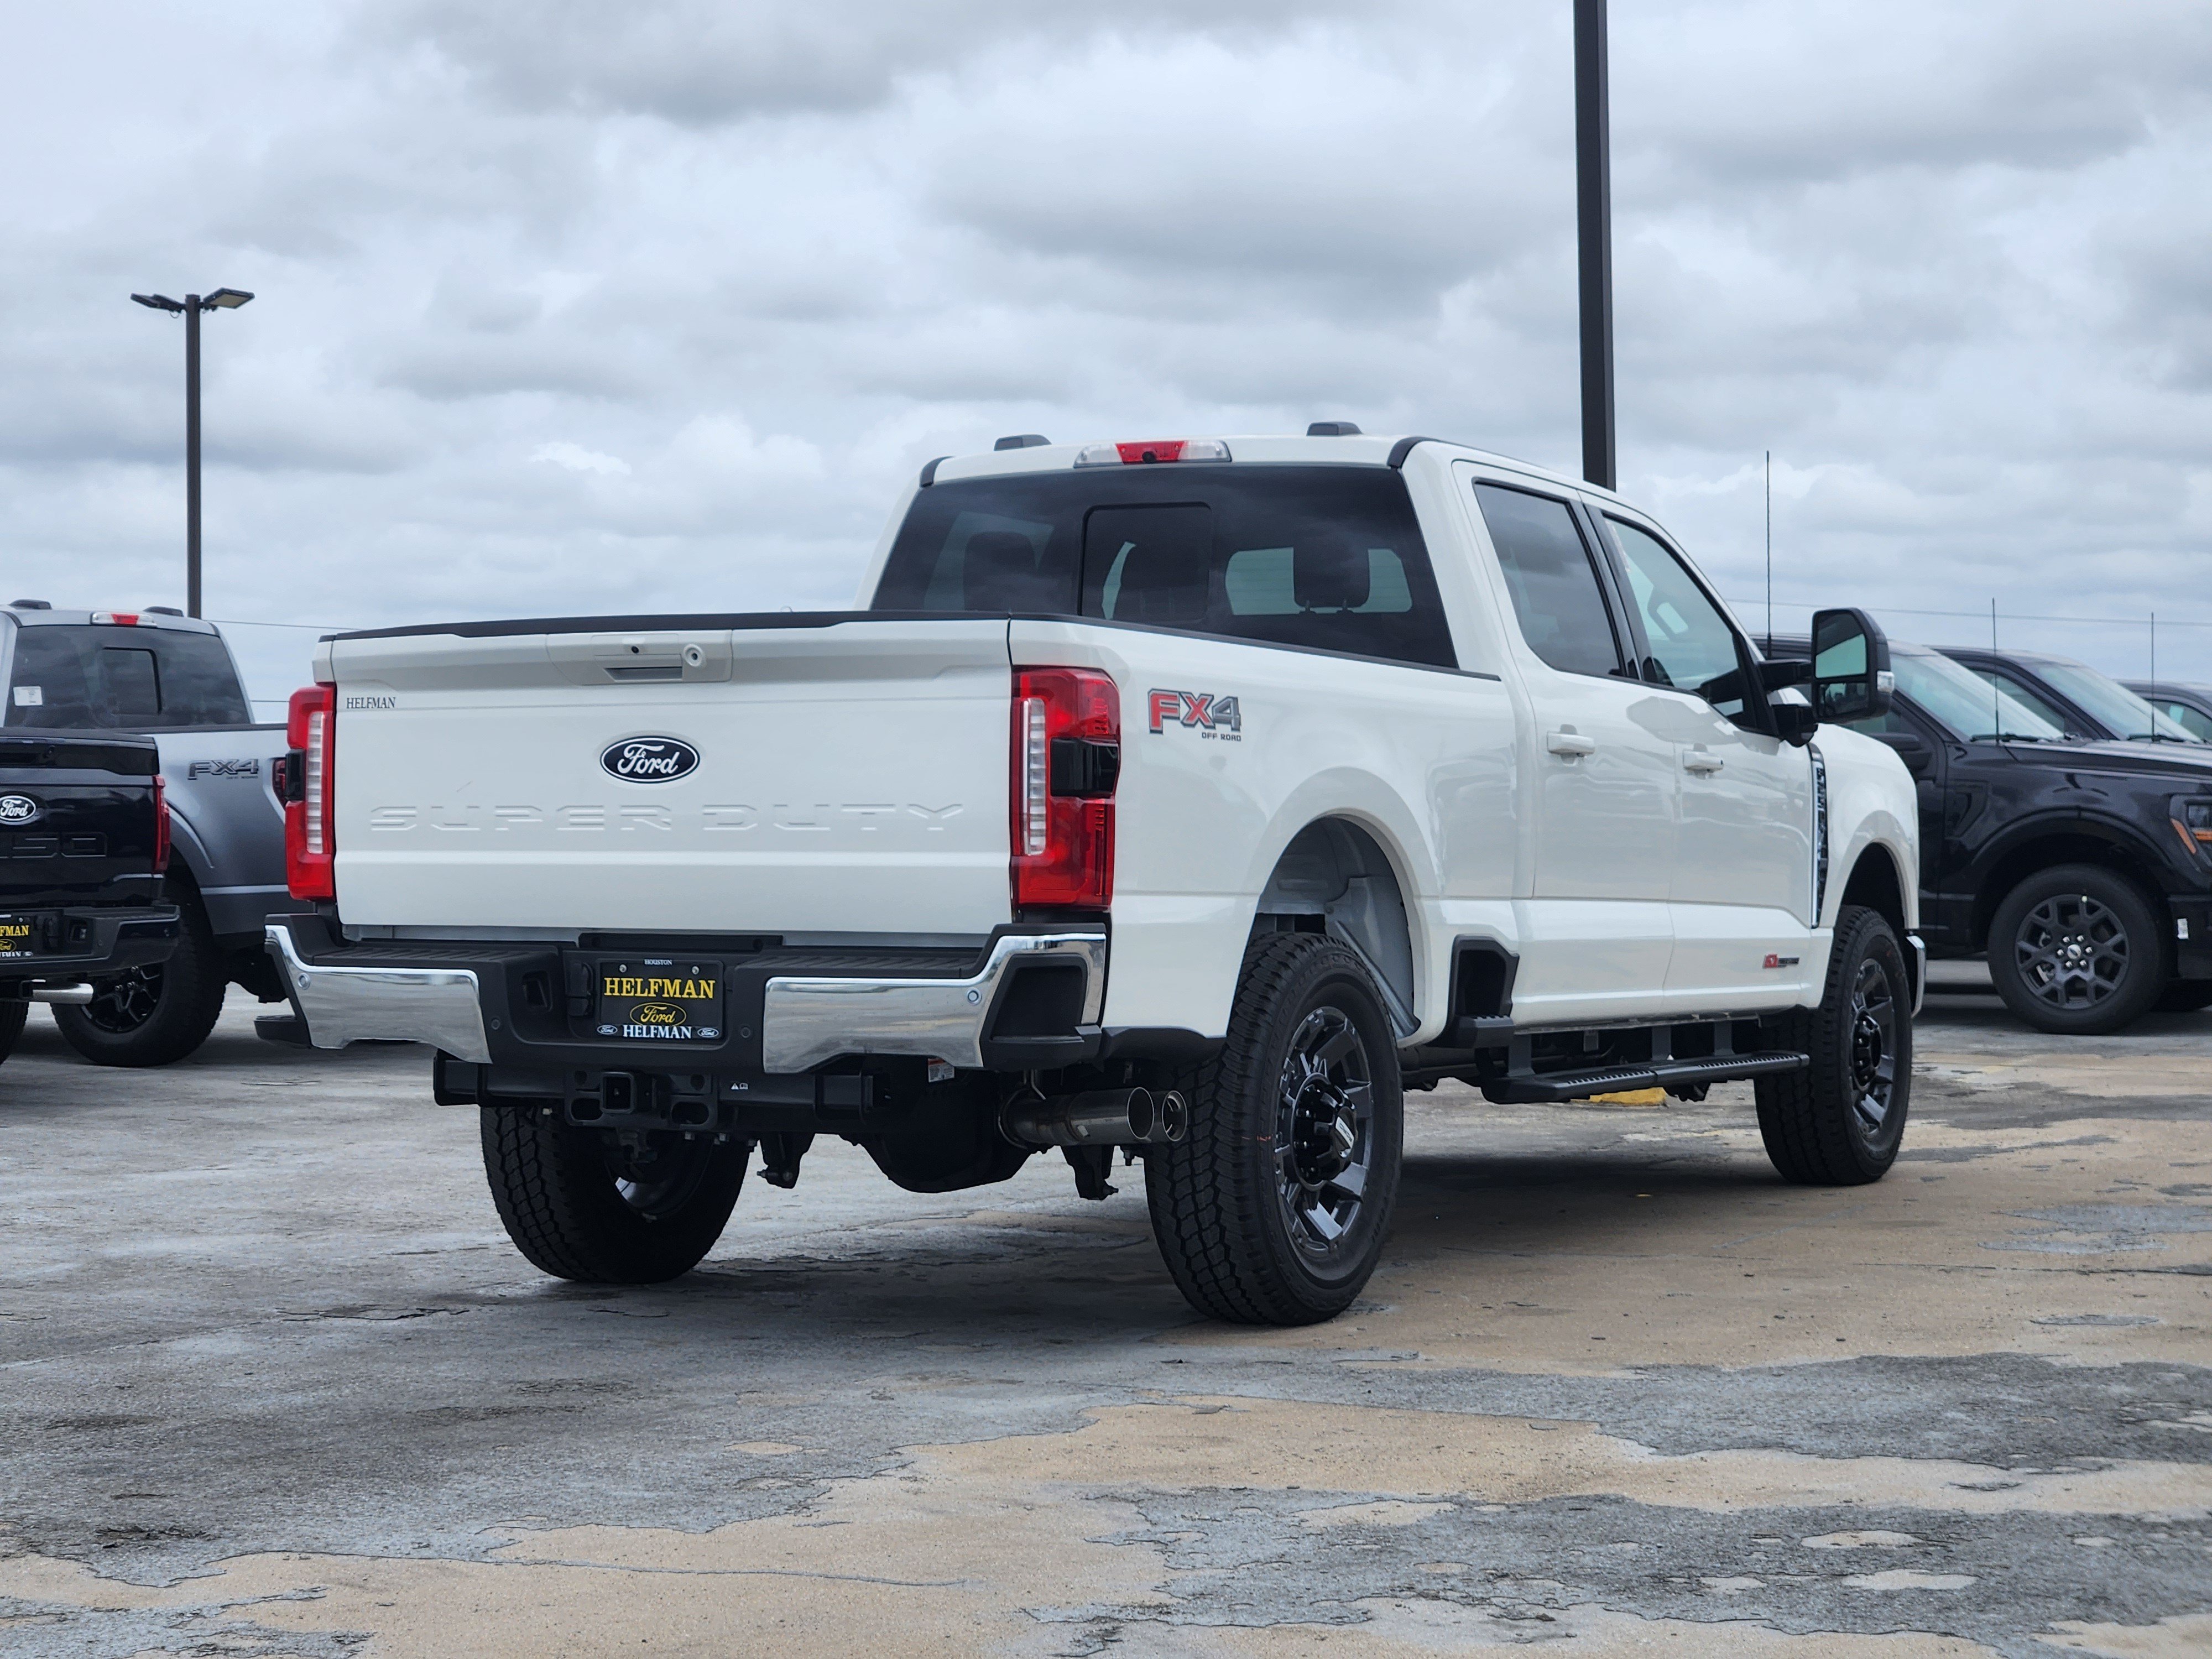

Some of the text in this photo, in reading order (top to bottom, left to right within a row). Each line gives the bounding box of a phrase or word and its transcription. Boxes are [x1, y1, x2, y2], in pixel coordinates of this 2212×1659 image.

[346, 697, 396, 708] HELFMAN
[1148, 688, 1241, 734] FX4
[1220, 733, 1241, 742] ROAD
[617, 744, 680, 774] Ford
[187, 759, 259, 780] FX4
[0, 799, 28, 817] Ford
[371, 804, 963, 831] SUPER DUTY
[604, 977, 716, 999] HELFMAN
[640, 1005, 676, 1023] Ford
[623, 1025, 692, 1039] HELFMAN
